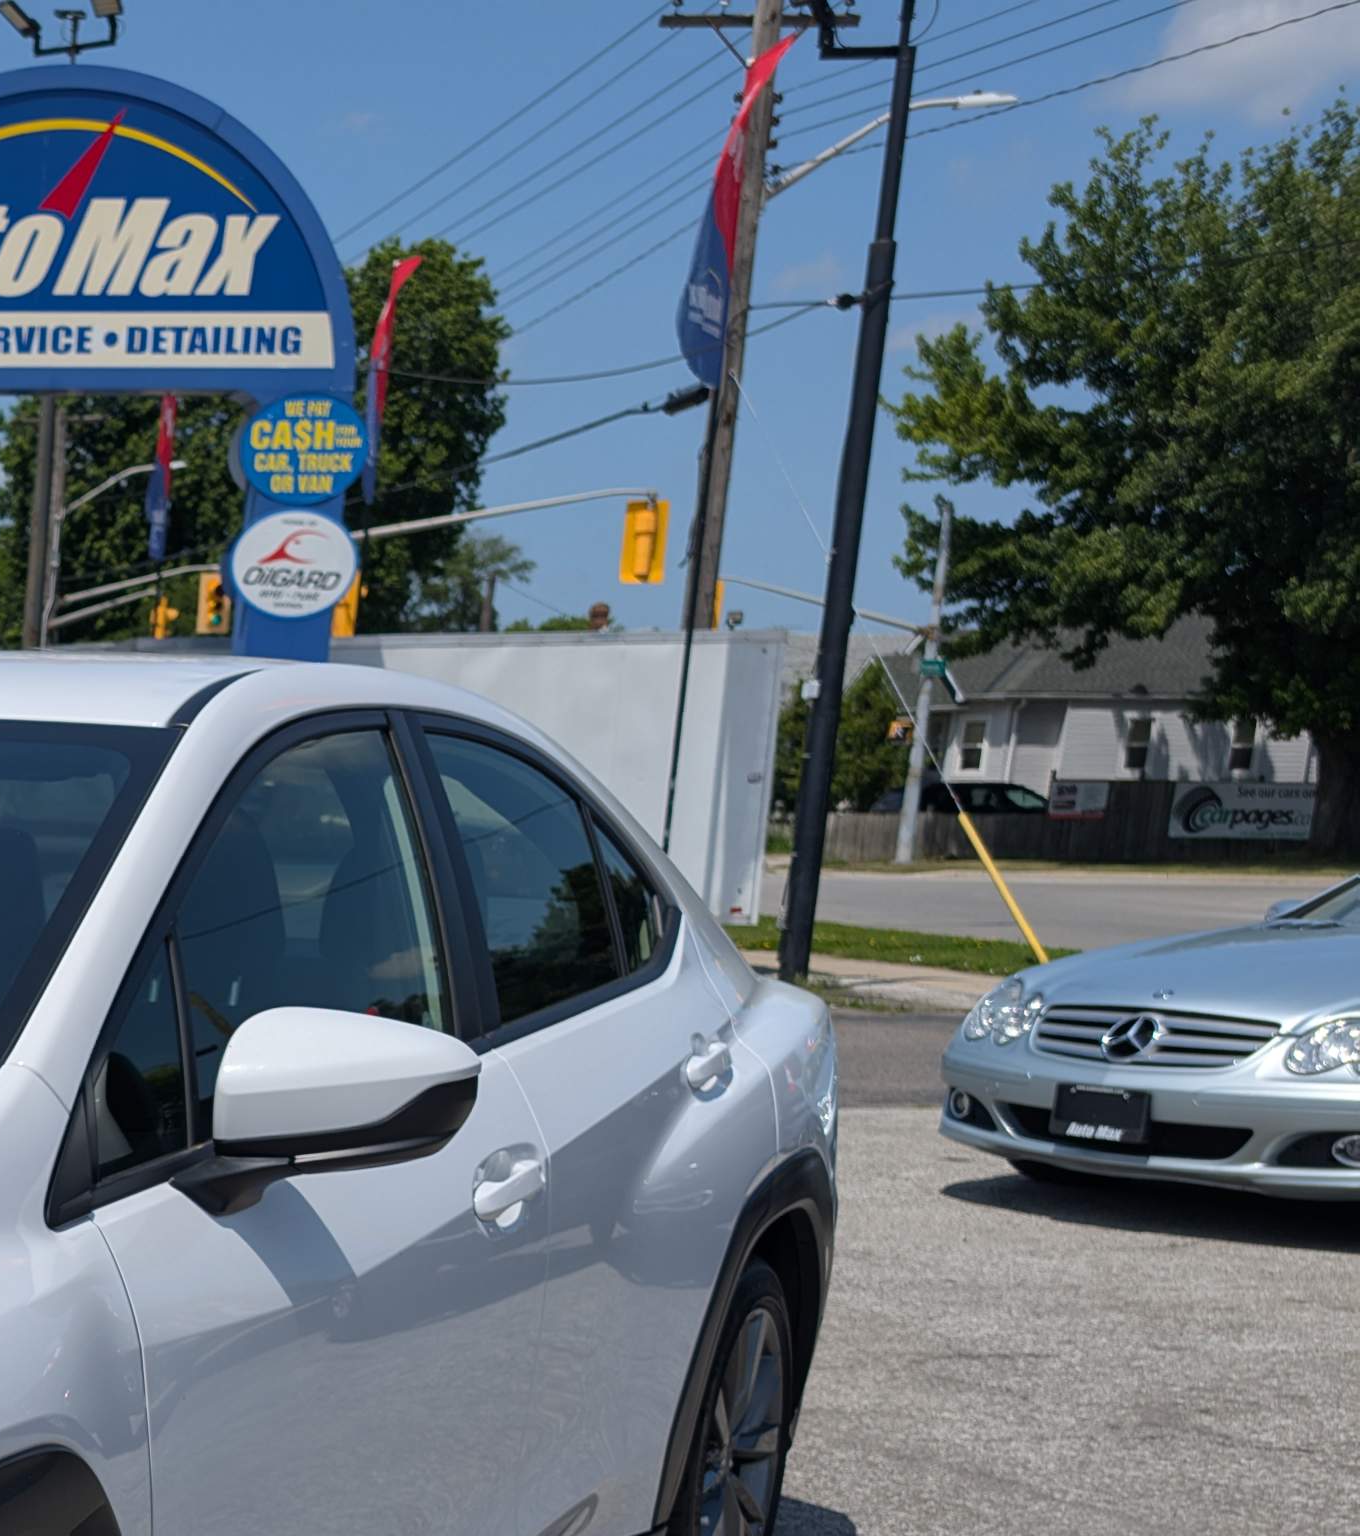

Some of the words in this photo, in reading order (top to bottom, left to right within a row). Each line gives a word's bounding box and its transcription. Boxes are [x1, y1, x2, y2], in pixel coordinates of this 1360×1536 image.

[125, 325, 303, 356] DETAILING
[284, 400, 304, 417] WE
[298, 453, 353, 472] TRUCK
[270, 474, 294, 493] OR
[298, 475, 333, 494] VAN
[1277, 788, 1300, 799] cars
